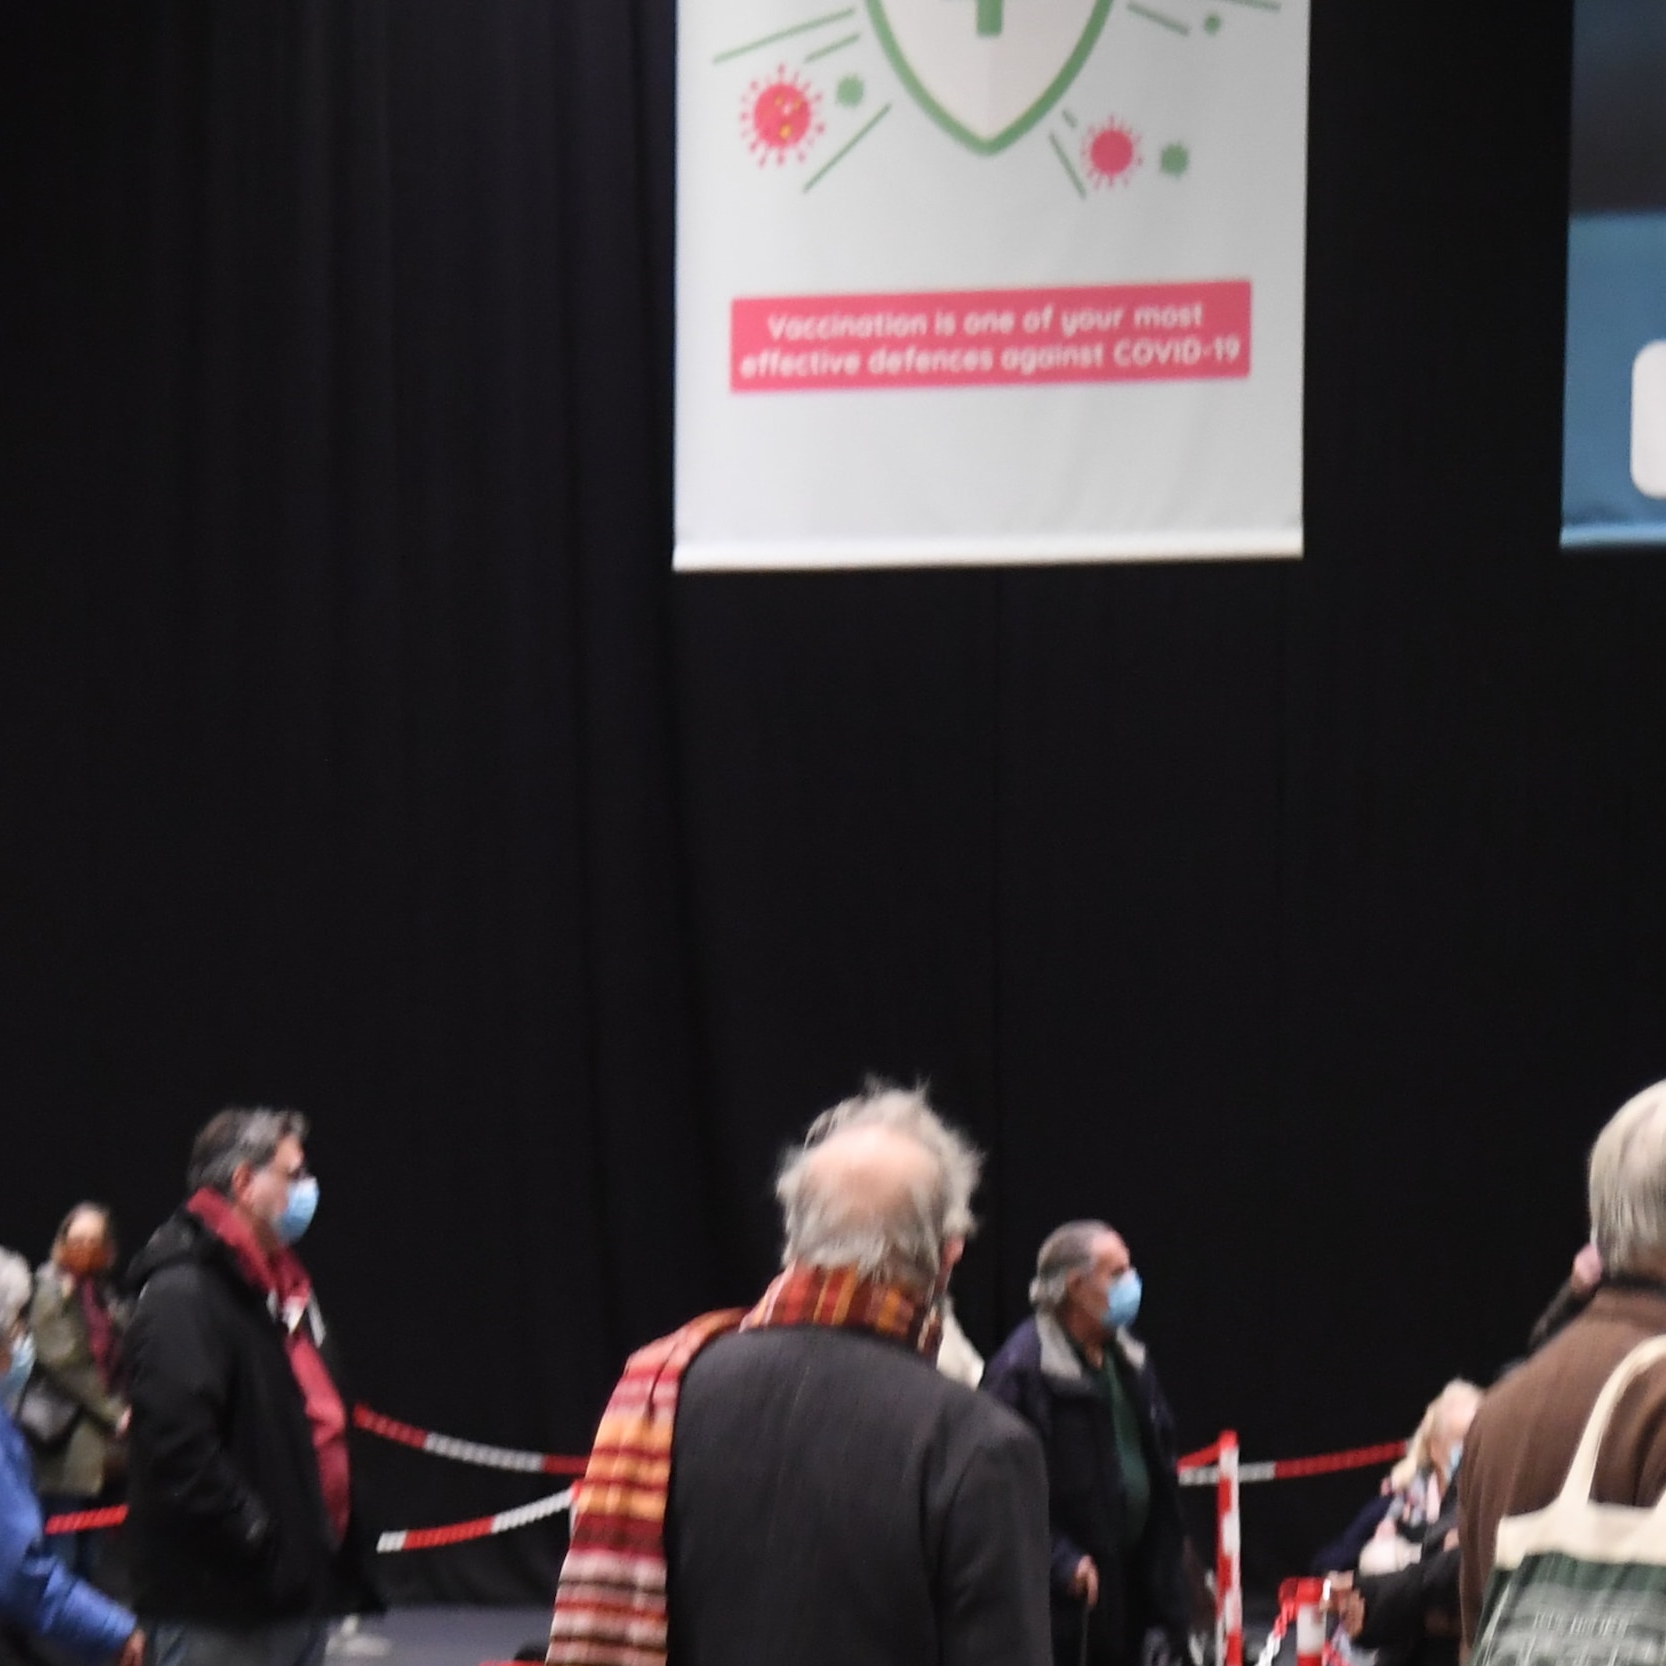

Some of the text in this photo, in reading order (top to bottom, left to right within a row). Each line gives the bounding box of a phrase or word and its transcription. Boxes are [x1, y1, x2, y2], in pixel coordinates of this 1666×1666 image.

[767, 301, 1204, 340] Vaccination is one of your most
[740, 334, 1240, 378] effective defences against COVID-19
